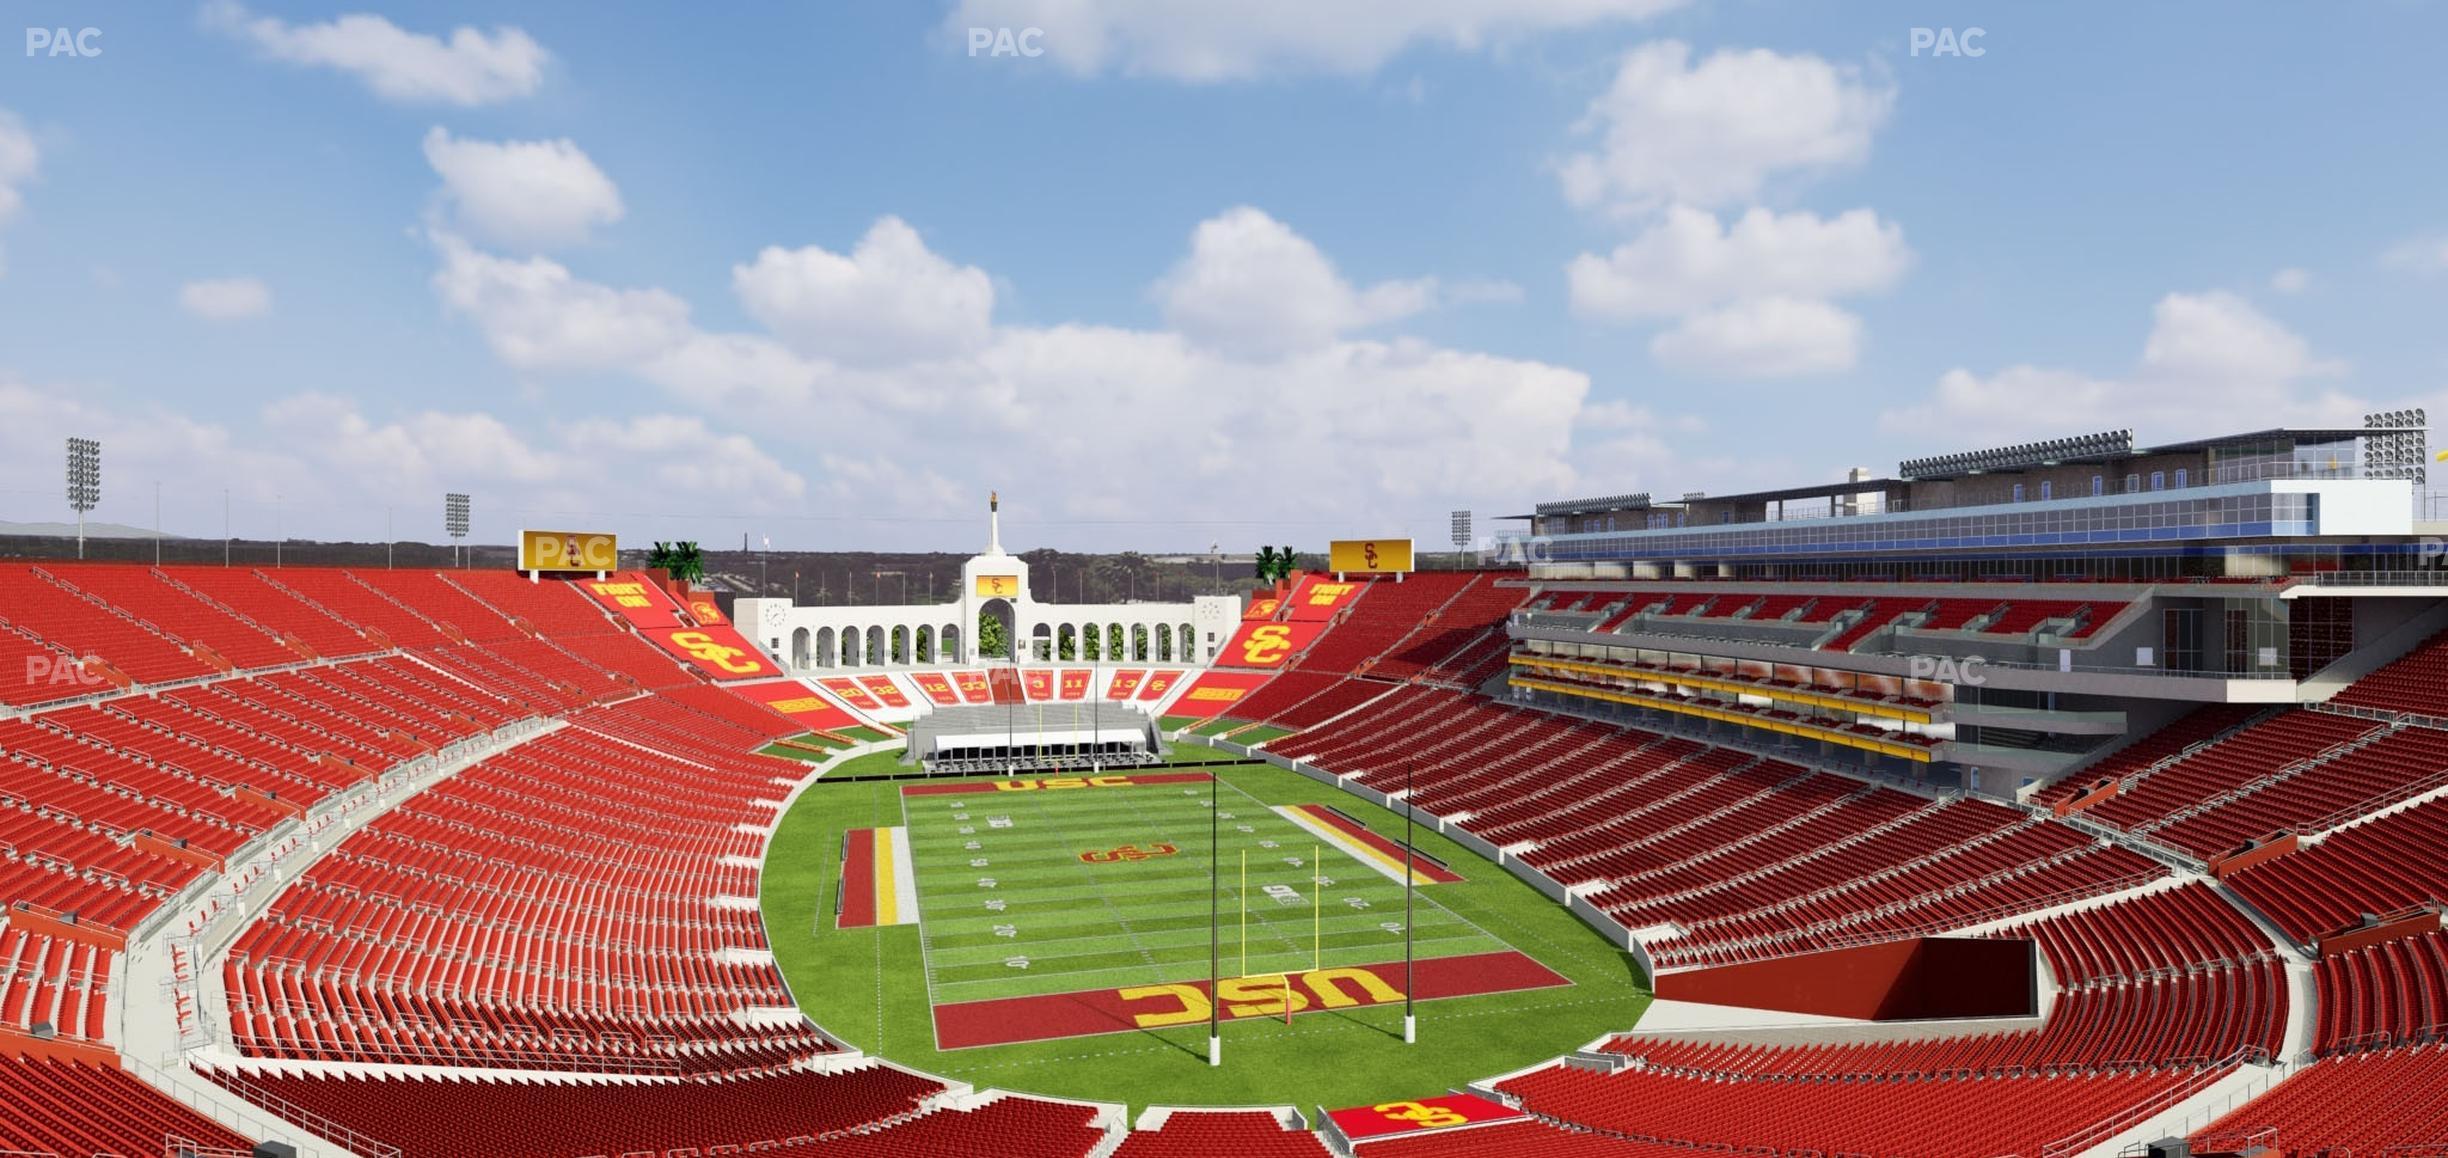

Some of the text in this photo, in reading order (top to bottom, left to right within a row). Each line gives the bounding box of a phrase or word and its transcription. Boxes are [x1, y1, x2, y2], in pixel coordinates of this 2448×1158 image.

[1365, 543, 1378, 569] SC
[991, 577, 1003, 594] SC
[670, 632, 761, 673] SC
[1243, 624, 1292, 663] SC
[925, 683, 949, 692] 12
[961, 681, 987, 692] 33
[1064, 679, 1083, 689] 11
[1113, 679, 1137, 689] 13
[994, 776, 1134, 791] USC
[1078, 844, 1178, 863] SC
[1118, 967, 1408, 1028] USC
[1373, 1102, 1469, 1127] SC
